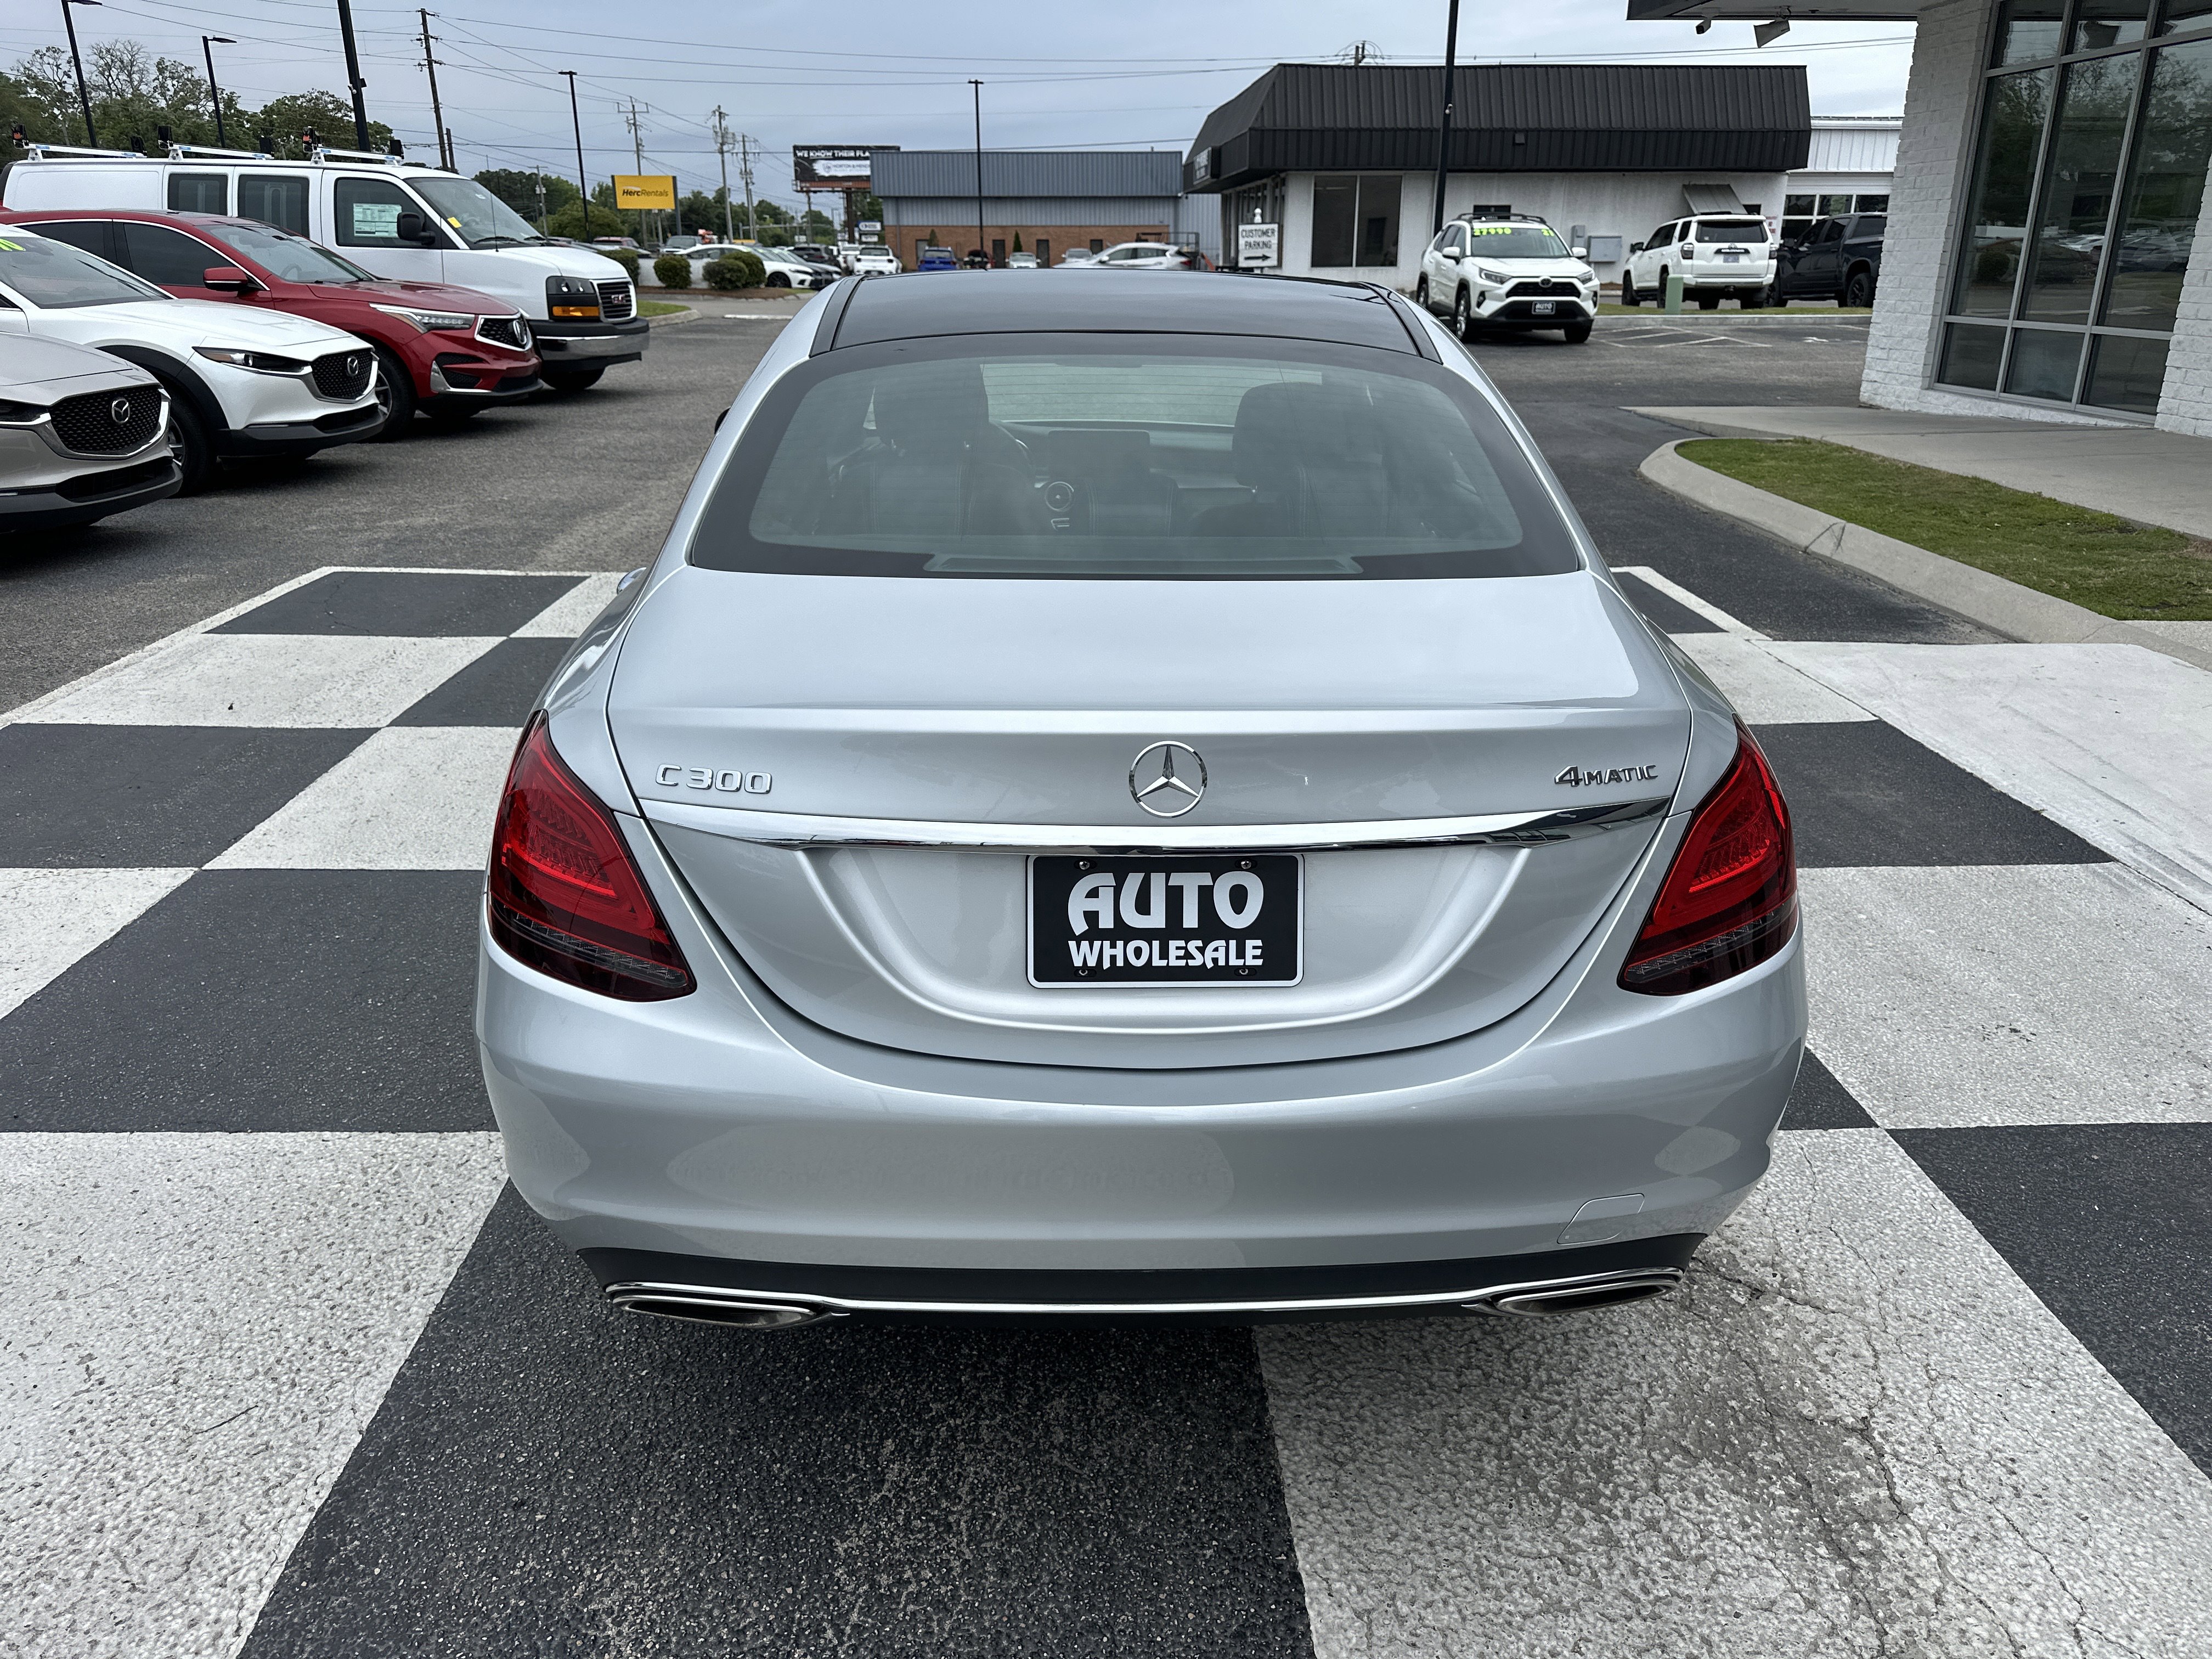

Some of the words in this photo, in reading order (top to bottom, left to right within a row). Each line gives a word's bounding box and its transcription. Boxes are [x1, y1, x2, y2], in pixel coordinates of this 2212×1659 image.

[622, 189, 669, 197] HercRentals
[1241, 228, 1276, 238] CUSTOMER
[1244, 240, 1272, 250] PARKING
[656, 764, 682, 786] C
[686, 767, 772, 794] 300
[1554, 765, 1658, 787] 4MATIC
[1068, 871, 1264, 936] AUTO
[1068, 939, 1264, 970] WHOLESALE
